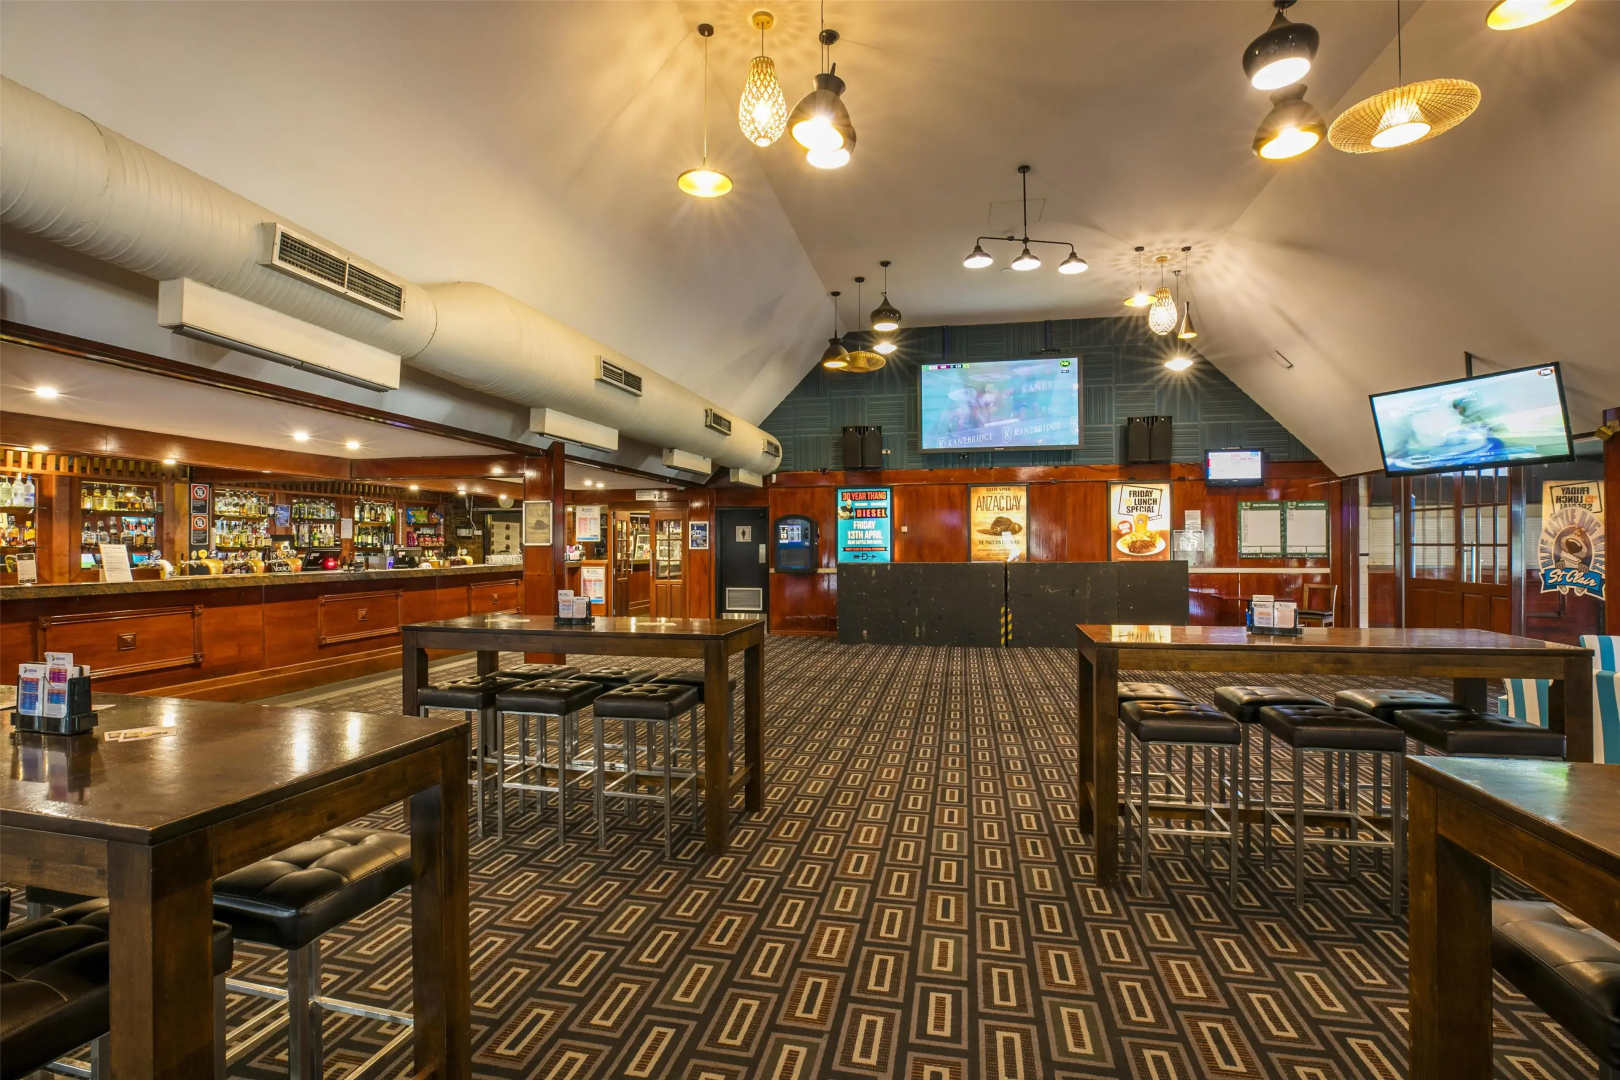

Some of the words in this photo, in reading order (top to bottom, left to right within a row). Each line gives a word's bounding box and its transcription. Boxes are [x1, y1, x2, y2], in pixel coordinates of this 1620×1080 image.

[948, 433, 993, 446] KANEBRIDGE
[1013, 421, 1062, 437] KANEBRIDGE
[842, 492, 851, 501] 30
[851, 492, 867, 500] YEAR
[867, 491, 887, 500] THANG
[976, 495, 1004, 511] ANZAC
[1006, 495, 1022, 511] DAY
[856, 509, 886, 518] DIESEL
[853, 520, 876, 529] FRIDAY
[1544, 509, 1576, 539] CATTLE
[1577, 511, 1601, 537] DOG
[847, 530, 864, 539] 13TH
[864, 530, 884, 539] APRIL
[1548, 569, 1567, 584] St
[1566, 569, 1597, 587] Clair
